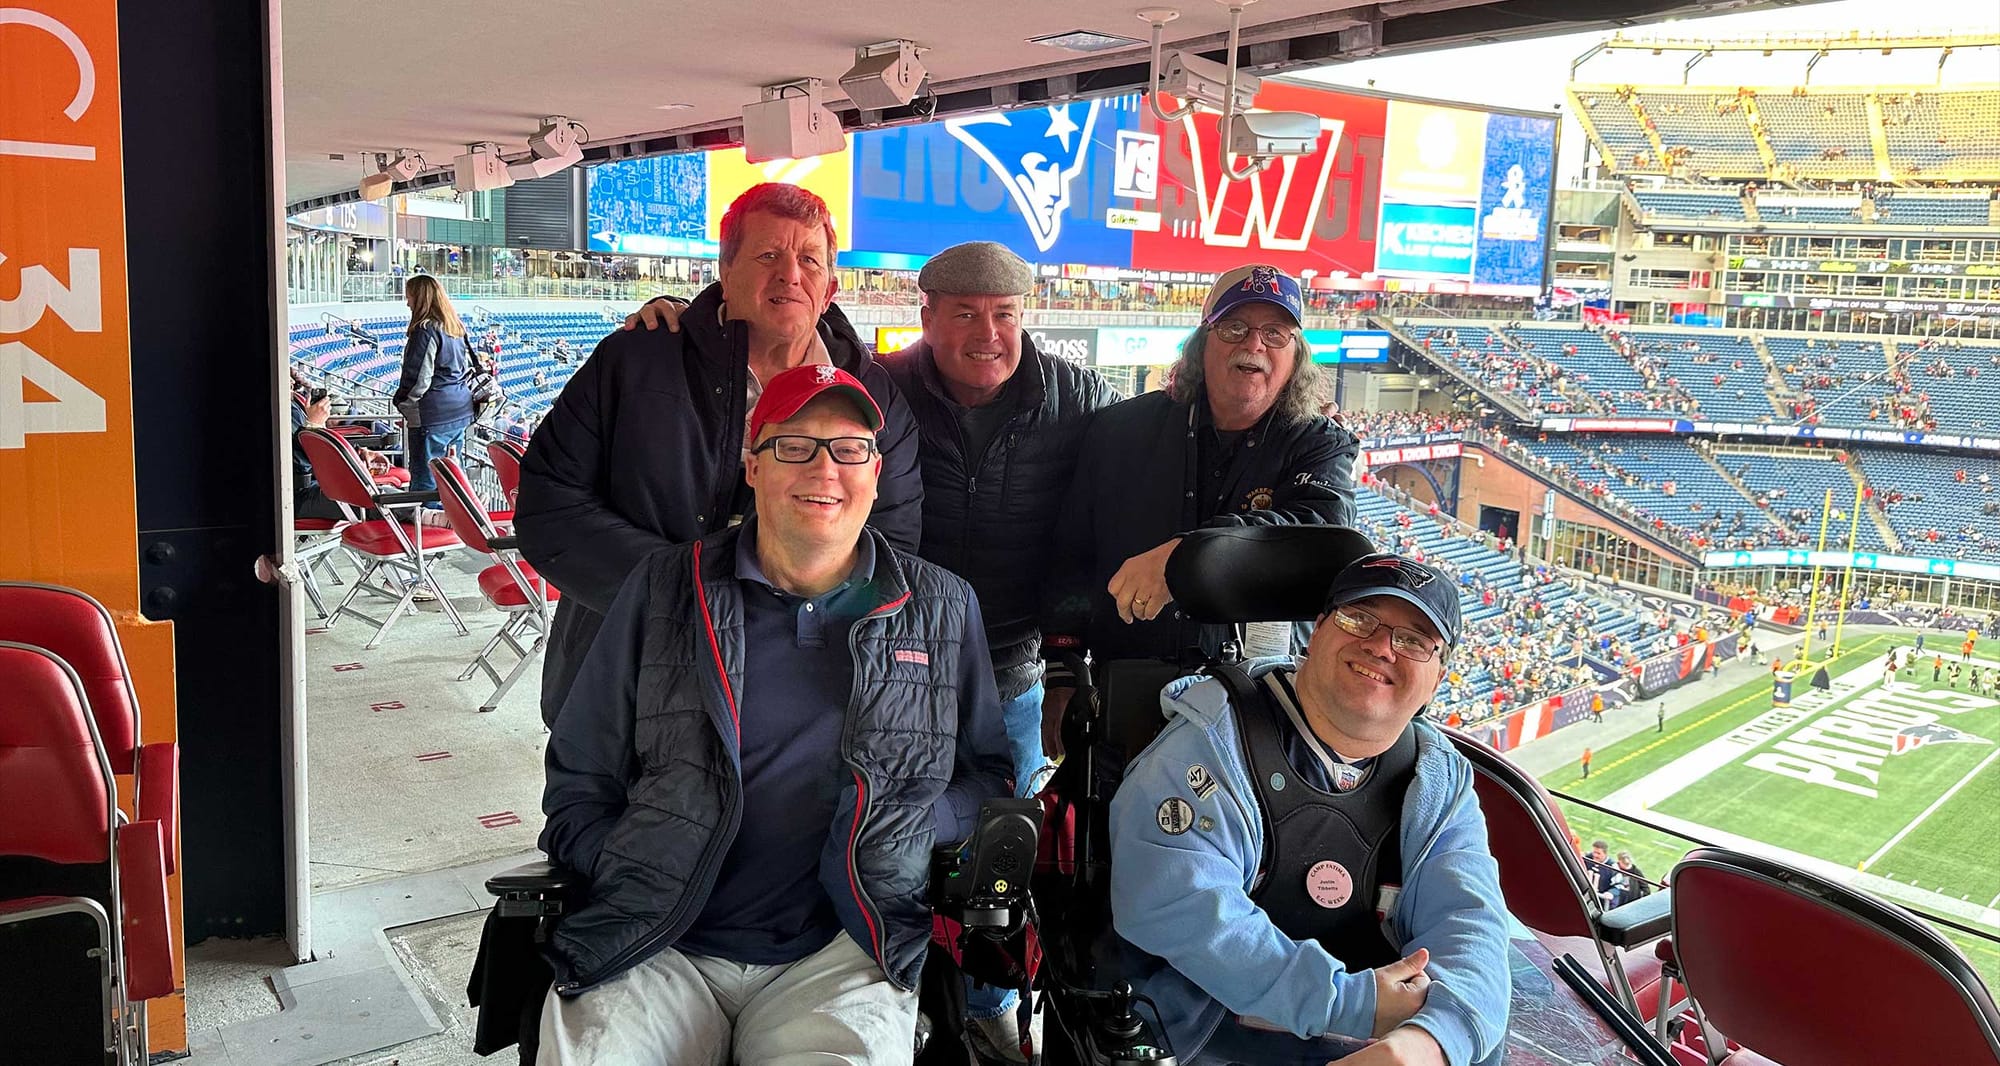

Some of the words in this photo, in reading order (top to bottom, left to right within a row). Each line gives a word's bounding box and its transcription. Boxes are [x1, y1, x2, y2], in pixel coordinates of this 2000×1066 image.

[1117, 137, 1157, 195] VS
[1743, 681, 2000, 799] PATRIOTS
[1311, 863, 1326, 878] CAMP
[1326, 863, 1346, 878] FATIMA
